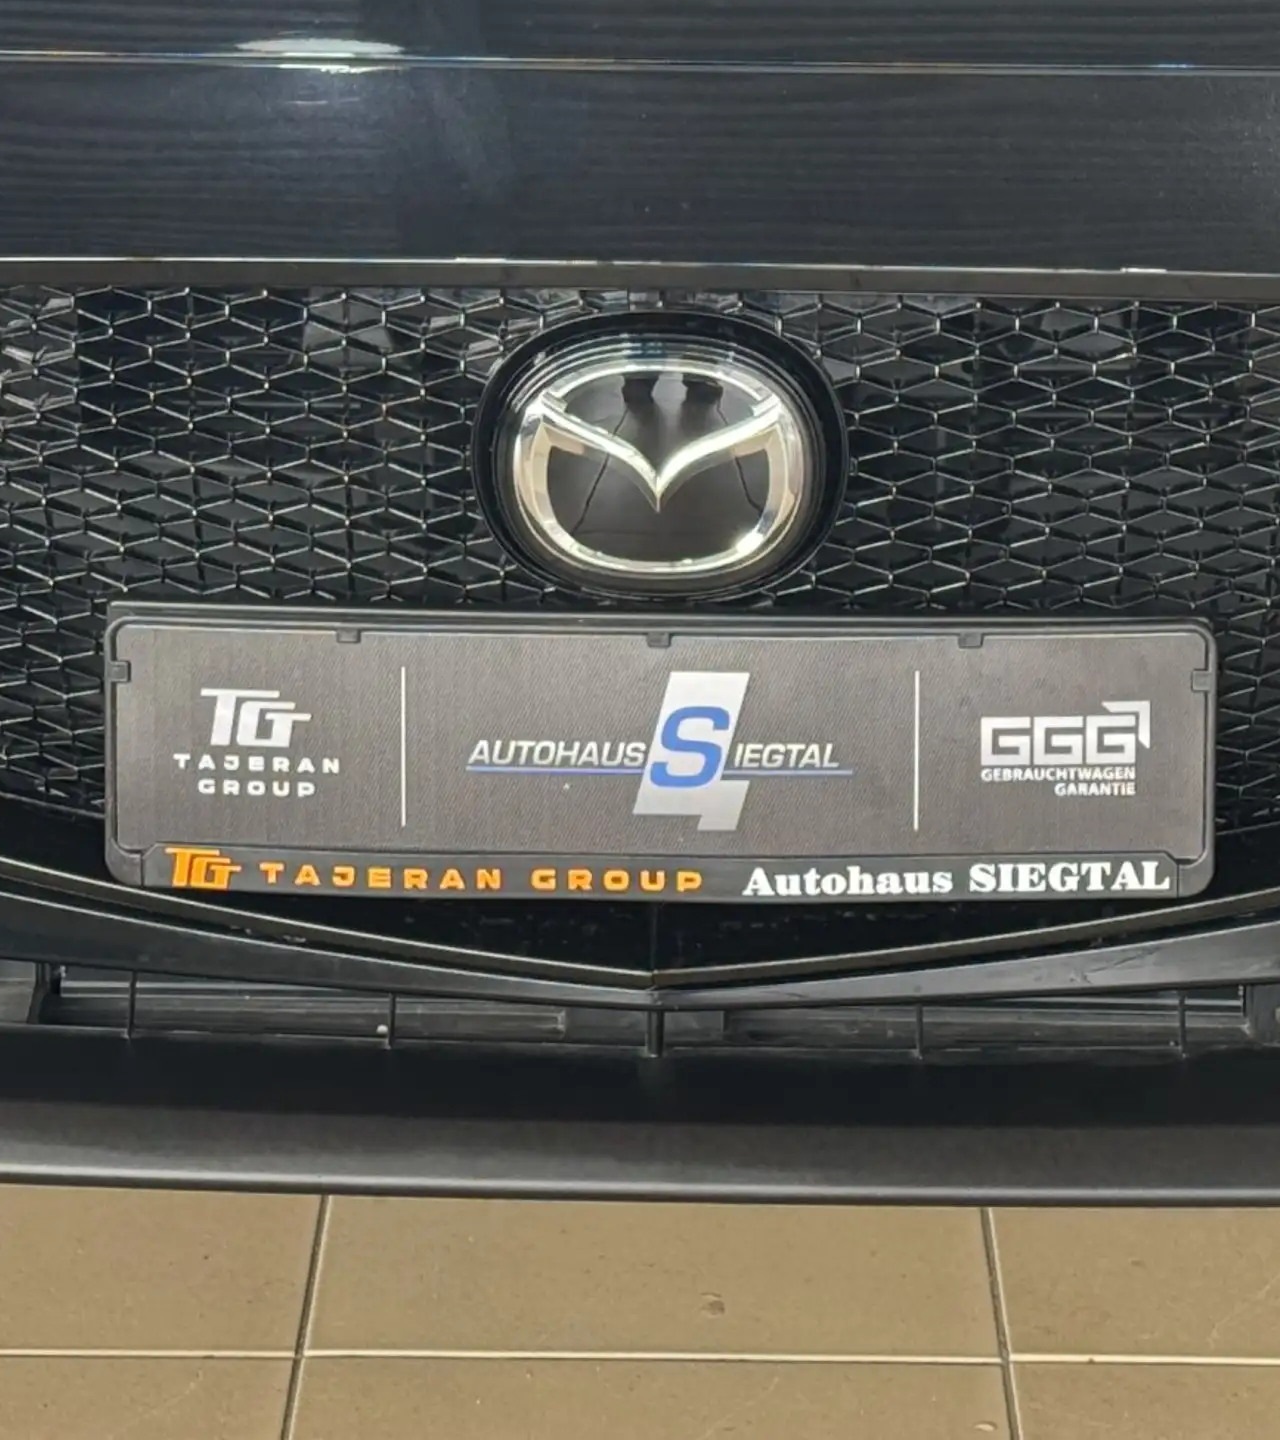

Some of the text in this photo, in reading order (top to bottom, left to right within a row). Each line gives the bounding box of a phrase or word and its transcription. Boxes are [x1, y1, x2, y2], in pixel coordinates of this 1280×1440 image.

[980, 714, 1137, 766] GGG
[172, 753, 341, 775] TAJERAN
[467, 739, 647, 768] AUTOHAUS
[980, 766, 1137, 782] GEBRAUCHTWAGEN
[197, 778, 316, 798] GROUP
[1053, 781, 1137, 797] GARANTIE
[259, 862, 503, 892] TAJERAN
[530, 868, 705, 893] GROUP
[742, 860, 1172, 898] Autohaus SIEGTAL
